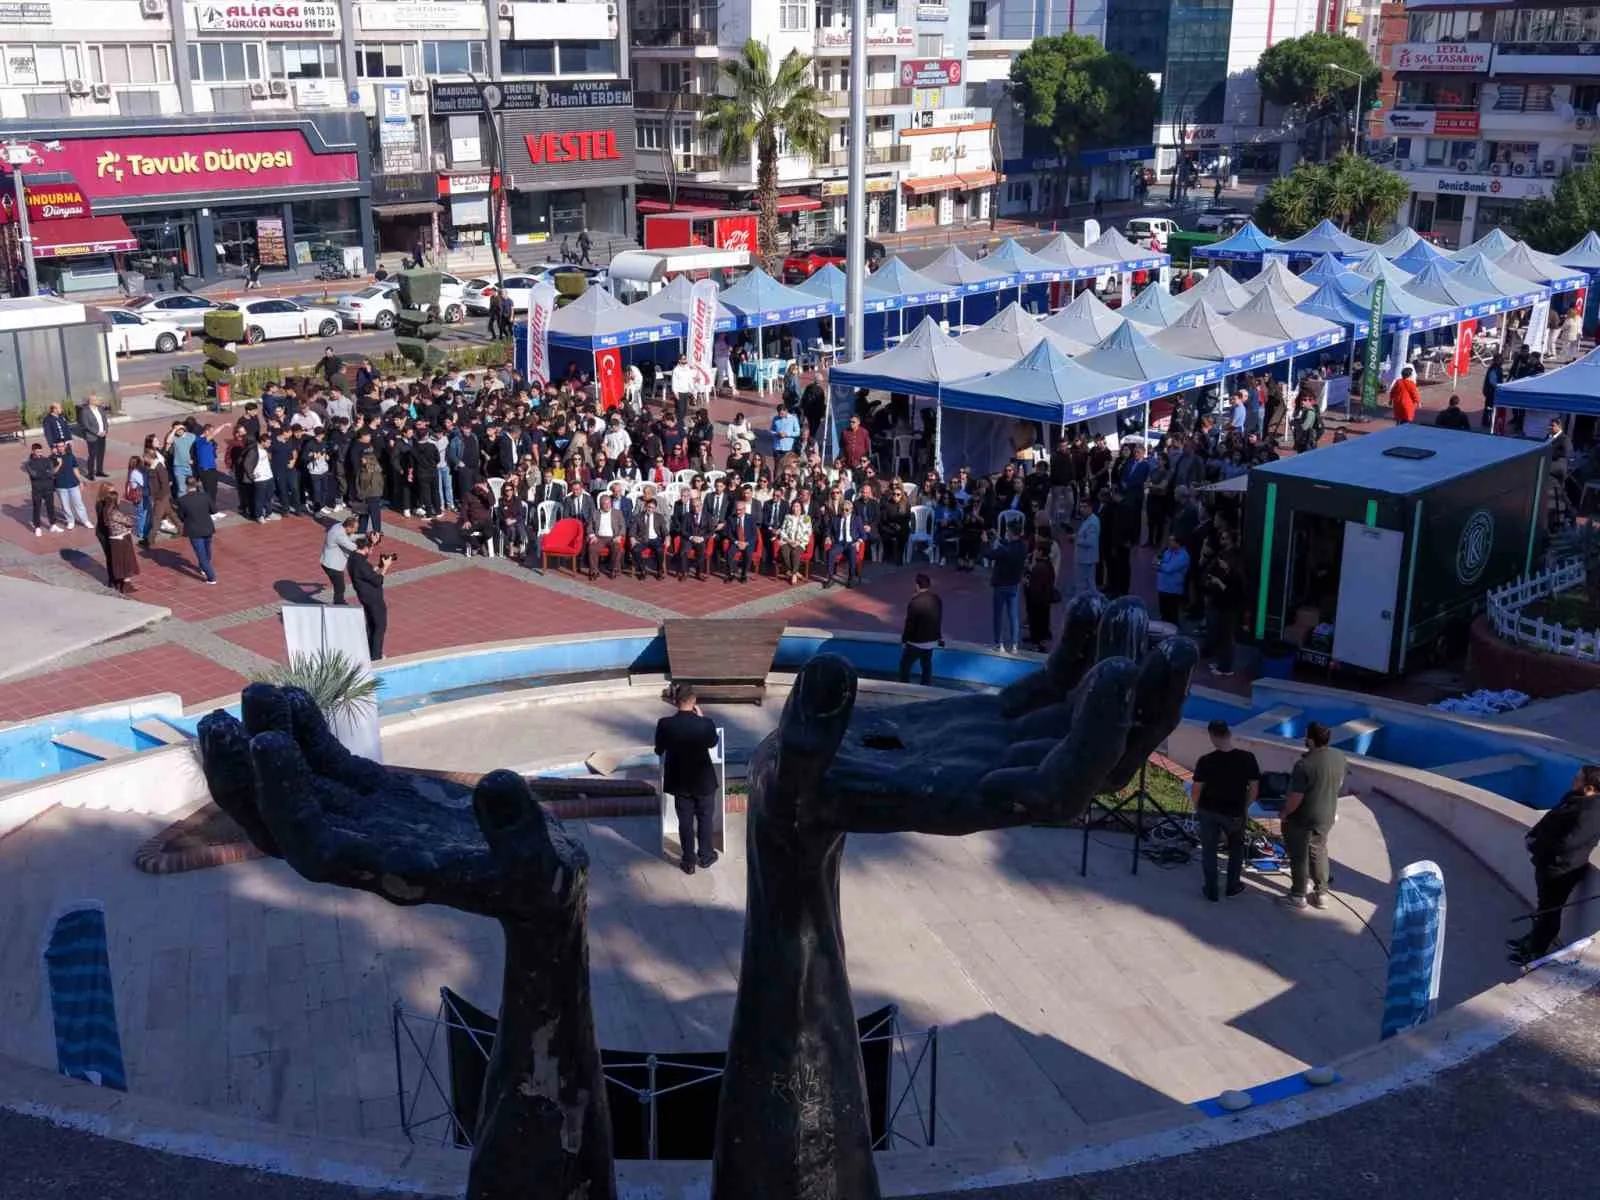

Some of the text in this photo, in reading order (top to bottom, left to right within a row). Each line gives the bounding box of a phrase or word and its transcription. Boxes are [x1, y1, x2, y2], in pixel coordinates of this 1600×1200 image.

[226, 3, 299, 17] ALİAĞA
[226, 19, 303, 29] SÜRÜCÜ KURSU
[1435, 54, 1484, 64] TASARIM
[551, 90, 631, 107] Hamit ERDEM
[523, 127, 624, 165] VESTEL
[127, 148, 293, 176] Tavuk Dünyası
[1437, 180, 1488, 193] DenizBank
[42, 204, 84, 218] Dünyası
